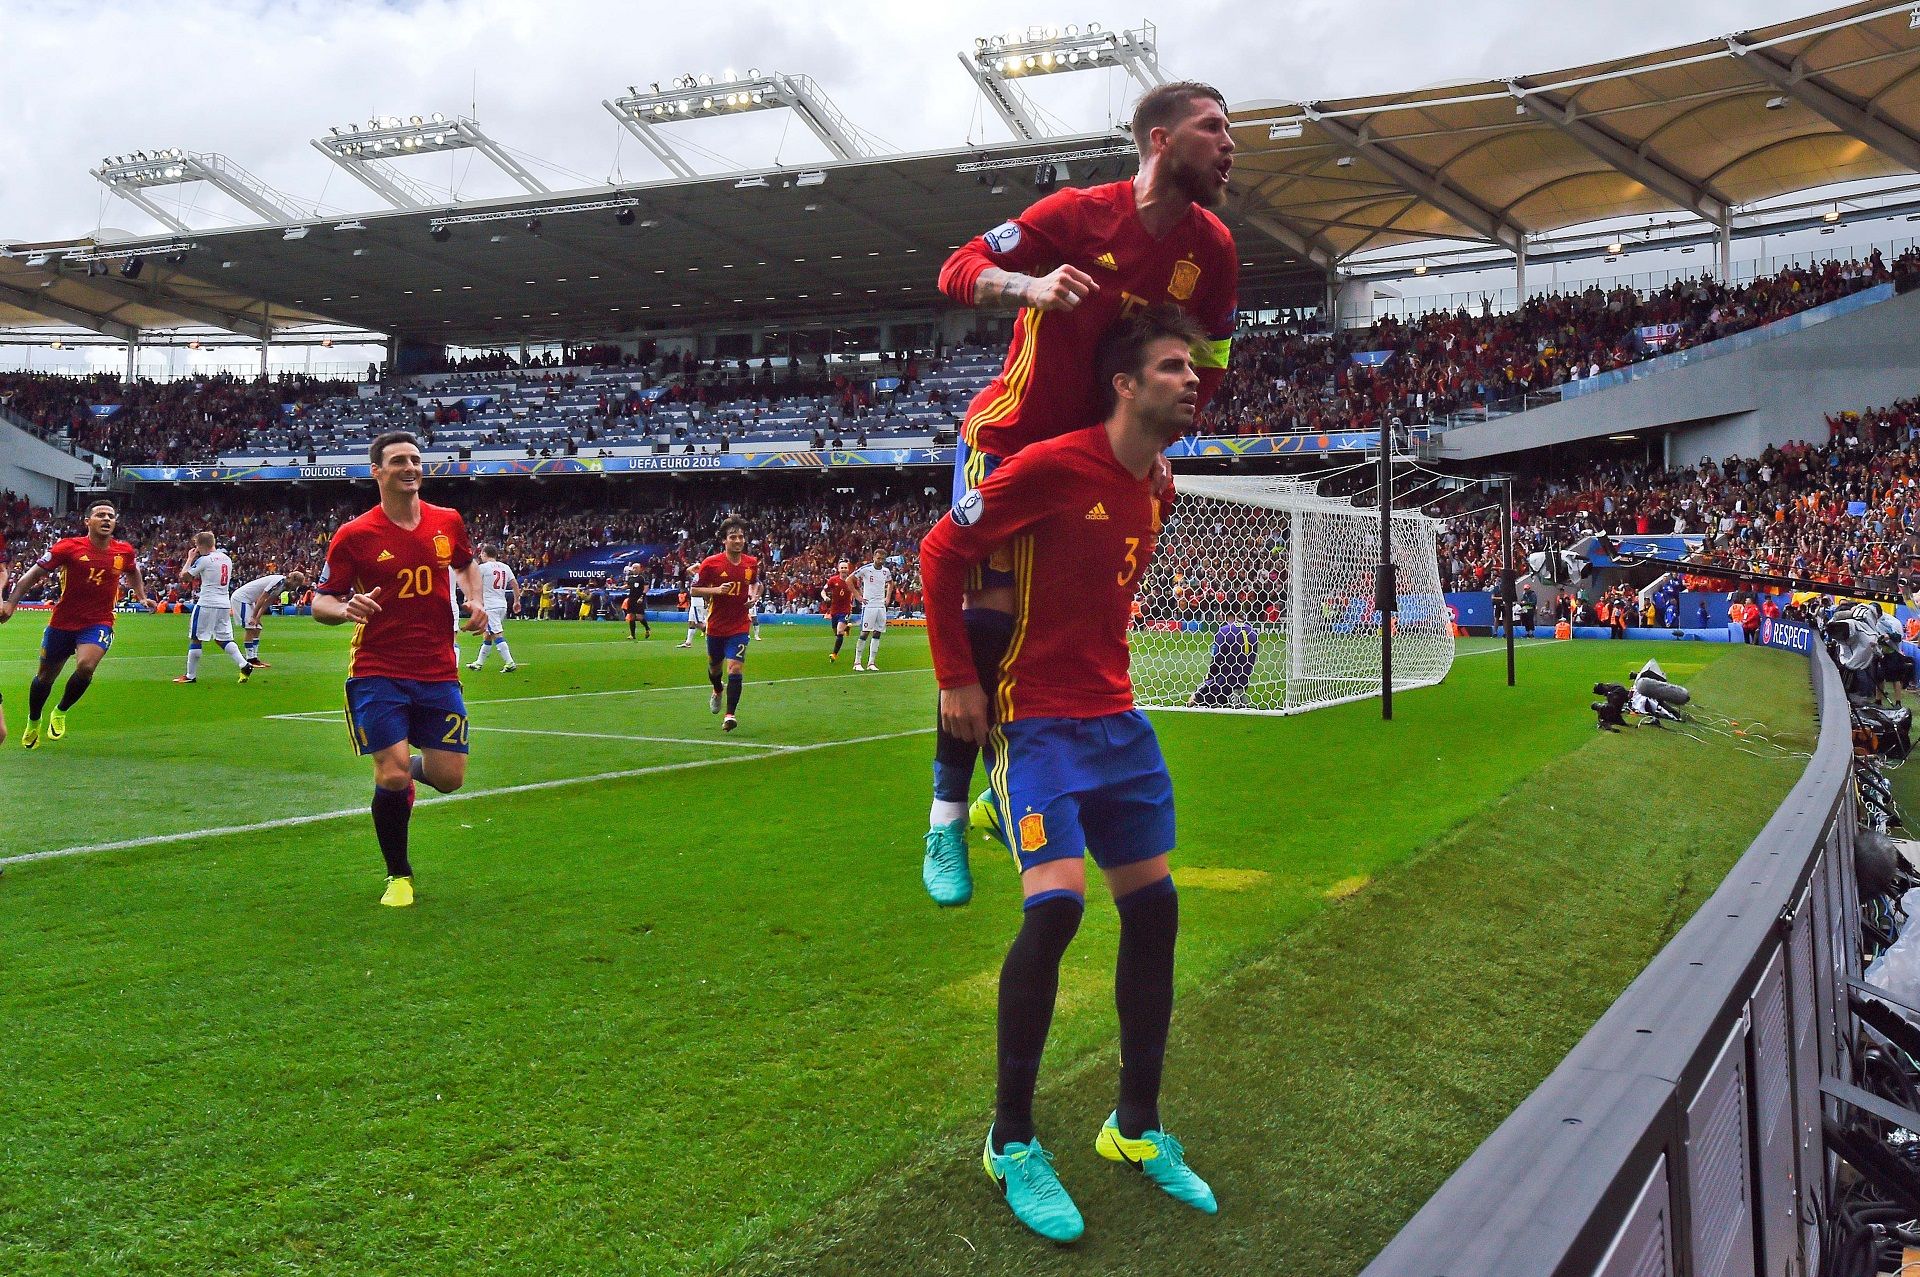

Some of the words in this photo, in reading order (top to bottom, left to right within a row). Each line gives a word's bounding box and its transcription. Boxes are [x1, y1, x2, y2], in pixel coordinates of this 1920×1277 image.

[300, 467, 346, 477] TOULOUSE
[629, 459, 658, 469] UEFA
[661, 458, 690, 468] EURO
[693, 457, 720, 468] 2016
[1117, 537, 1139, 586] 3
[89, 567, 105, 586] 14
[220, 563, 228, 586] 8
[396, 565, 432, 599] 20
[493, 570, 506, 590] 21
[568, 570, 606, 578] TOULOUSE
[728, 581, 741, 596] 21
[1772, 622, 1809, 650] RESPECT
